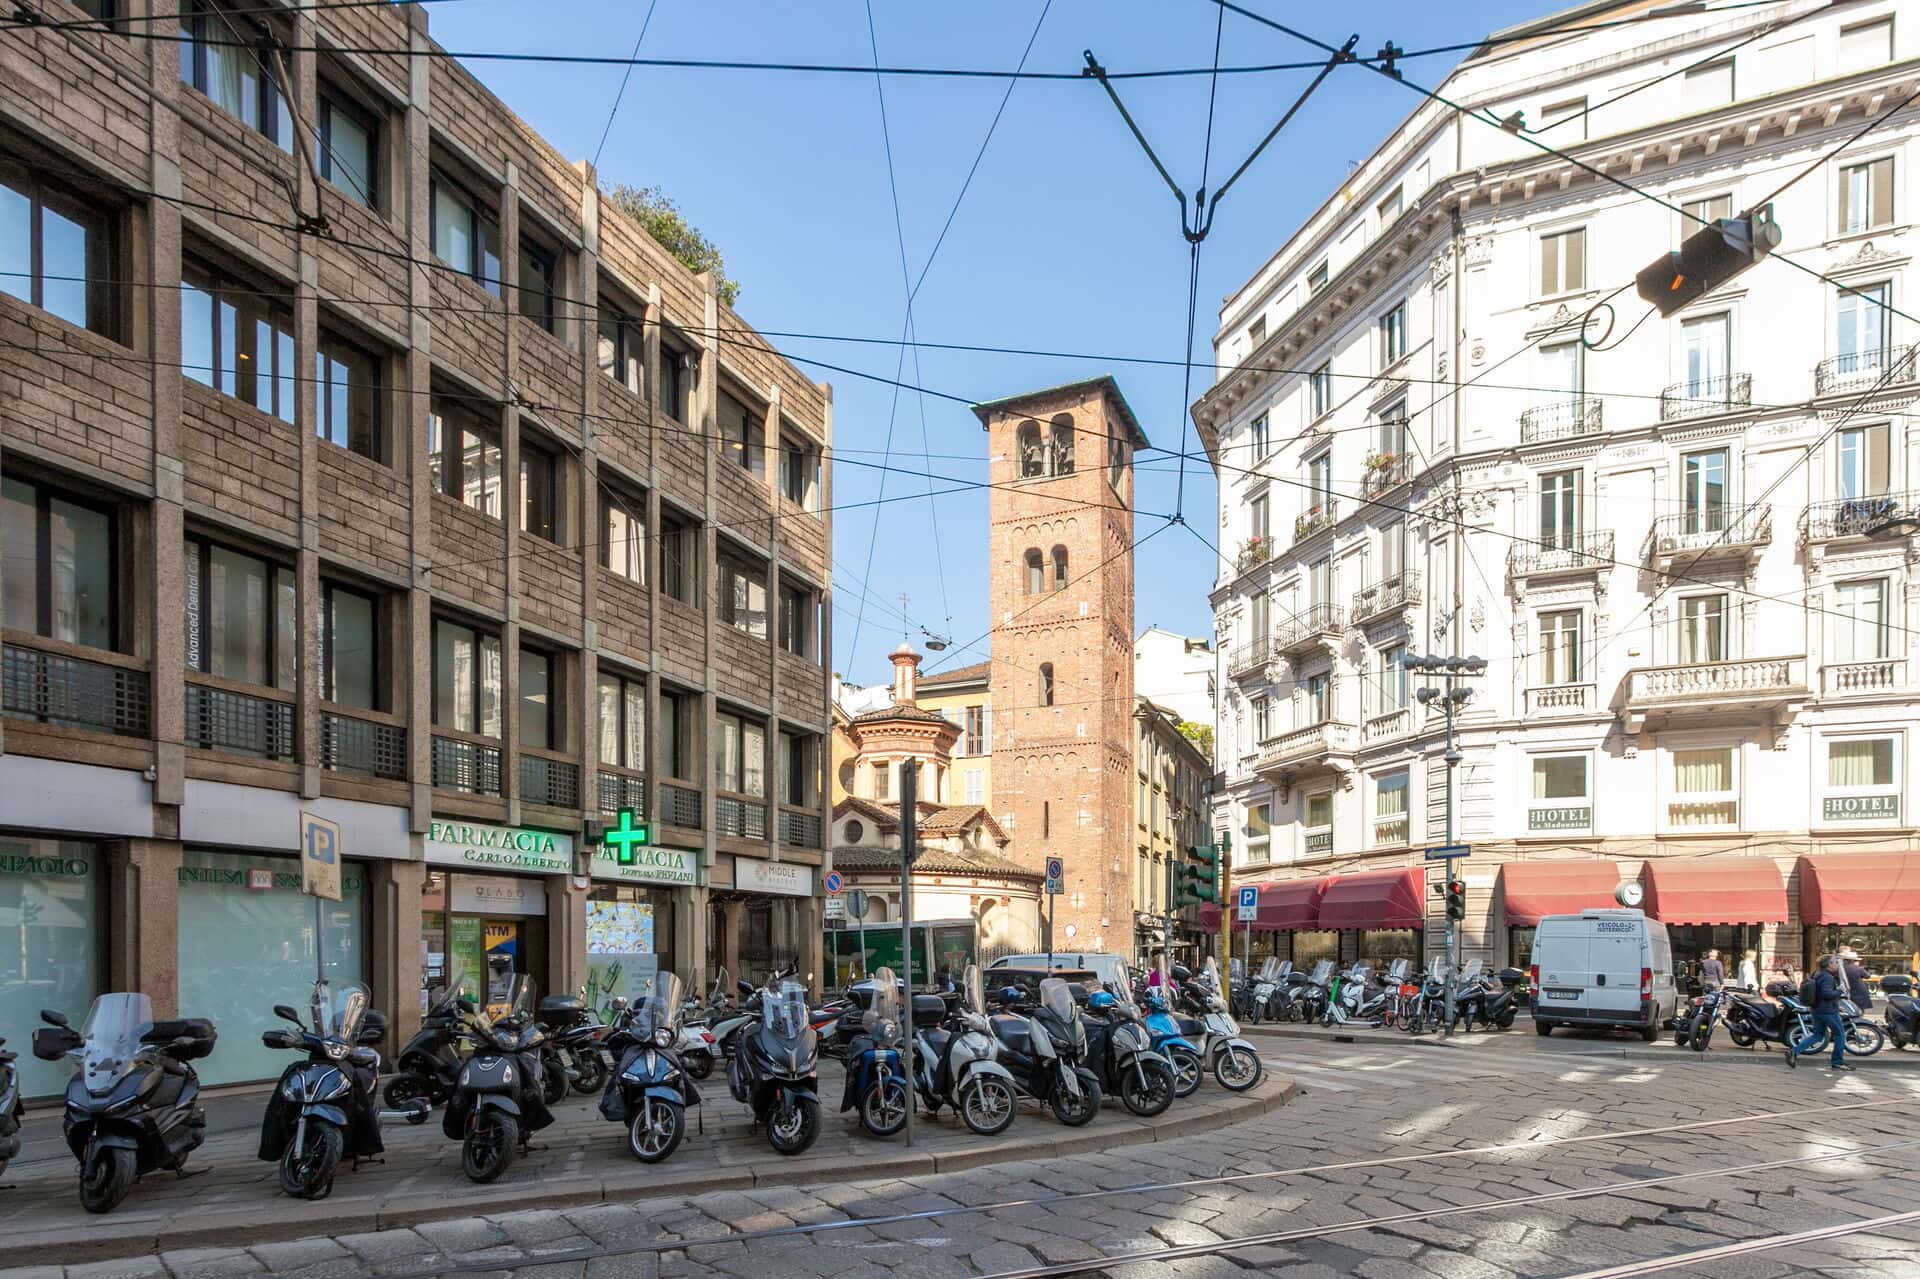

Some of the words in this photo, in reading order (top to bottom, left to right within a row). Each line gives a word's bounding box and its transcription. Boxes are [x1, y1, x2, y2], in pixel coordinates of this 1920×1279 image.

[187, 575, 200, 612] Dental
[187, 612, 200, 669] Advanced
[1832, 797, 1894, 812] HOTEL
[1536, 809, 1588, 822] HOTEL
[313, 827, 331, 857] P
[428, 822, 556, 853] FARMACIA
[768, 865, 797, 879] MIDDLE
[1244, 891, 1254, 905] P
[484, 925, 510, 937] ATM
